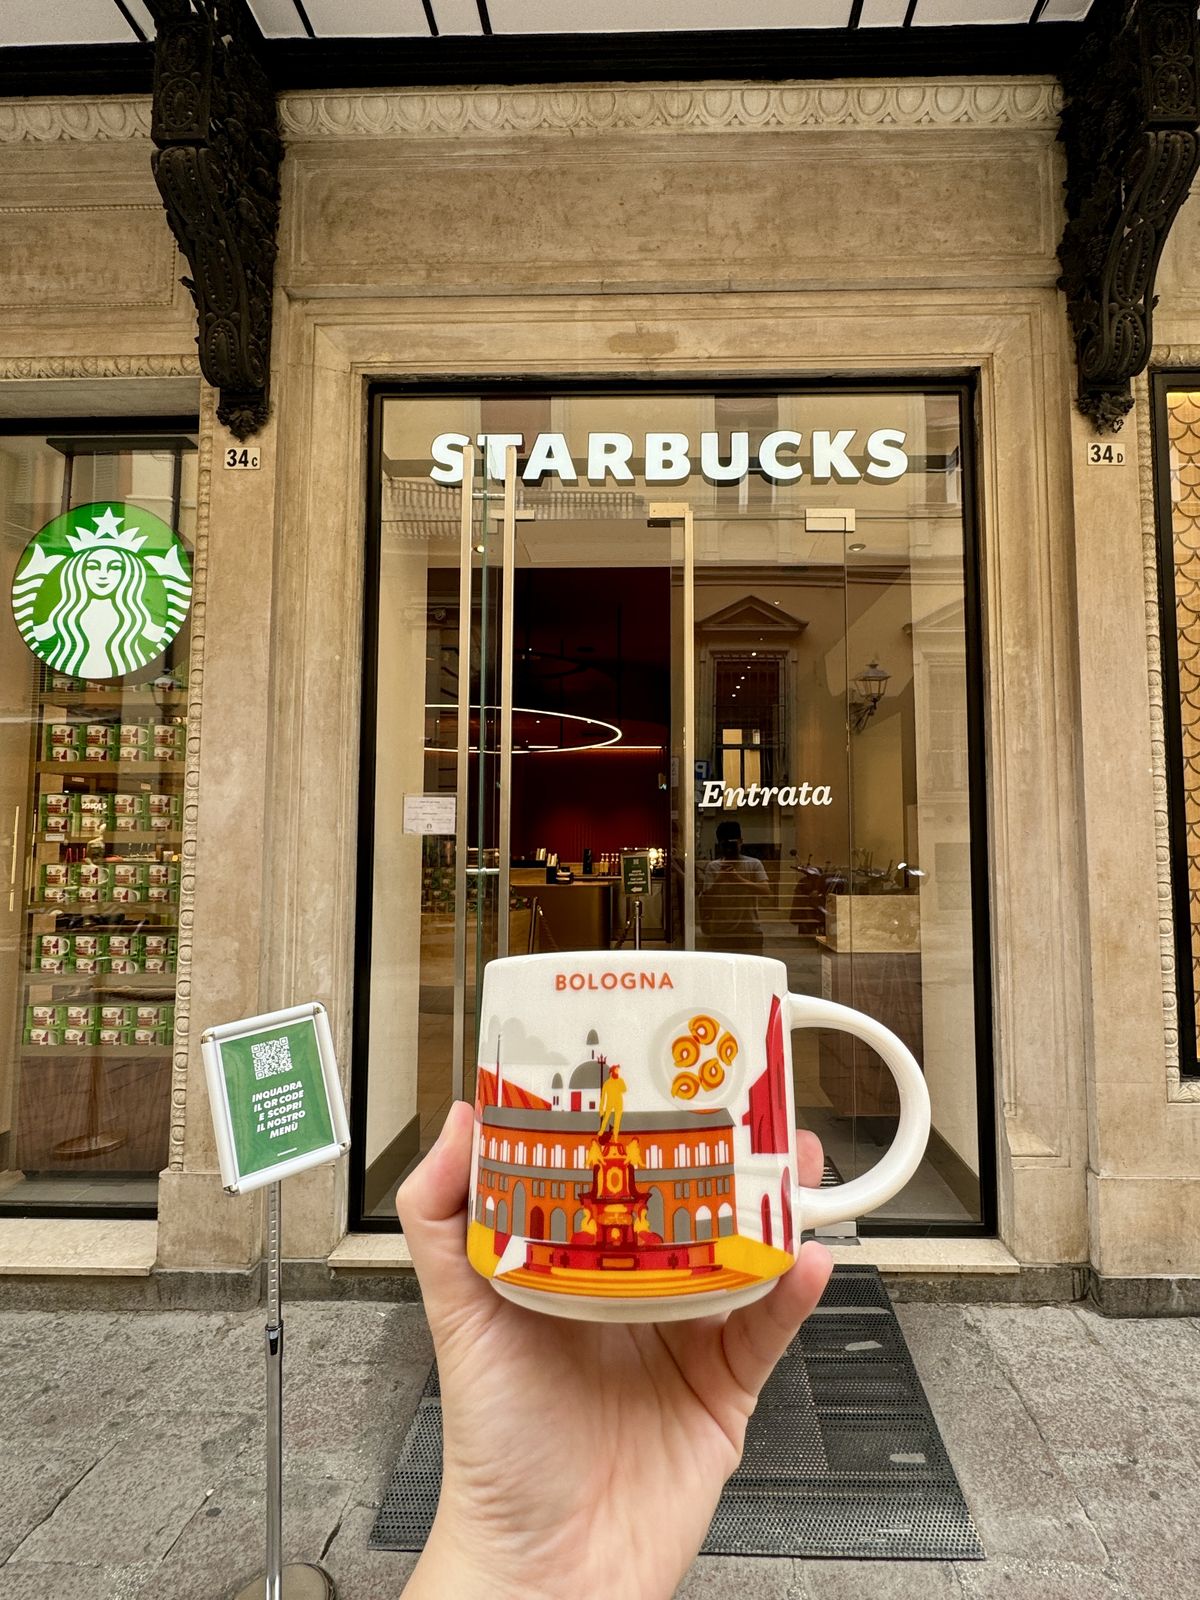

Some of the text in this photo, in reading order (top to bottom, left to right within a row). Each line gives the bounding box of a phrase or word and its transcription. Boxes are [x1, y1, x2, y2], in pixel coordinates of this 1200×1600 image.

[429, 428, 909, 484] STARBUCKS
[698, 780, 833, 807] Entrata
[555, 971, 674, 991] BOLOGNA
[252, 1080, 303, 1103] INQUADRA
[253, 1089, 304, 1112] IL QR CODE
[256, 1110, 306, 1133] IL NOSTRO
[258, 1100, 303, 1121] E SCOPRI
[270, 1121, 299, 1139] MENÙ
